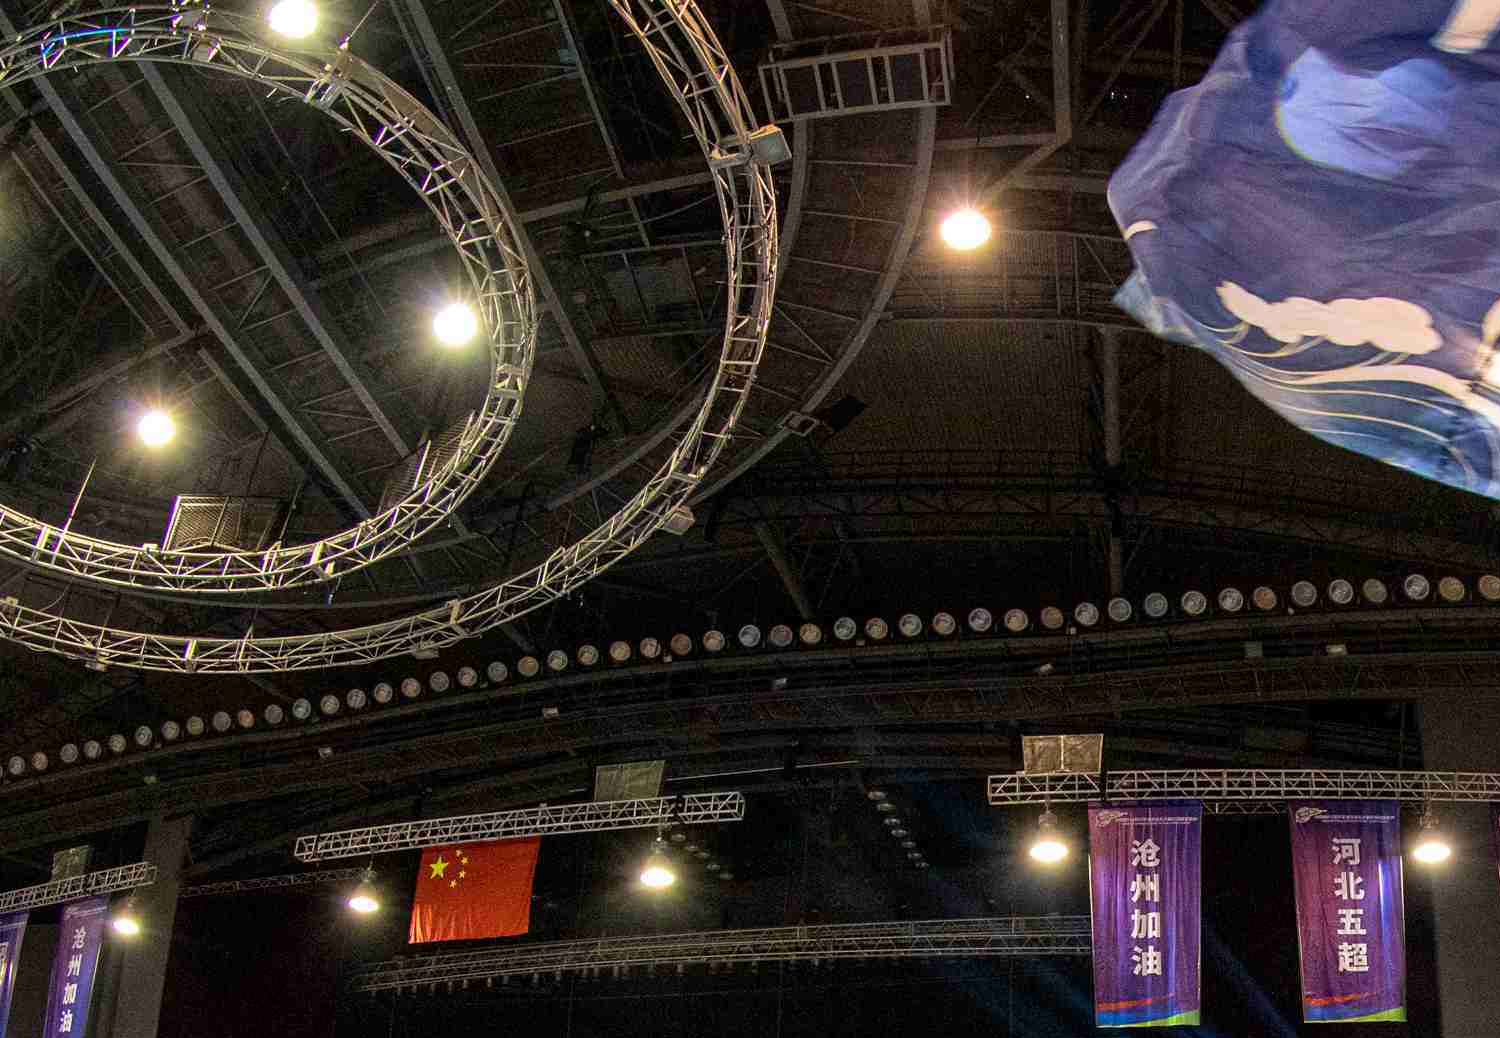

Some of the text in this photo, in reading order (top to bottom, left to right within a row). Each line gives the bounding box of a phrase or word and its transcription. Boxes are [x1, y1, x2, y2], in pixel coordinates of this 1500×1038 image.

[1130, 838, 1163, 977] 沧州加油
[1331, 837, 1369, 974] 河北五超
[59, 925, 87, 1032] 沧州加油
